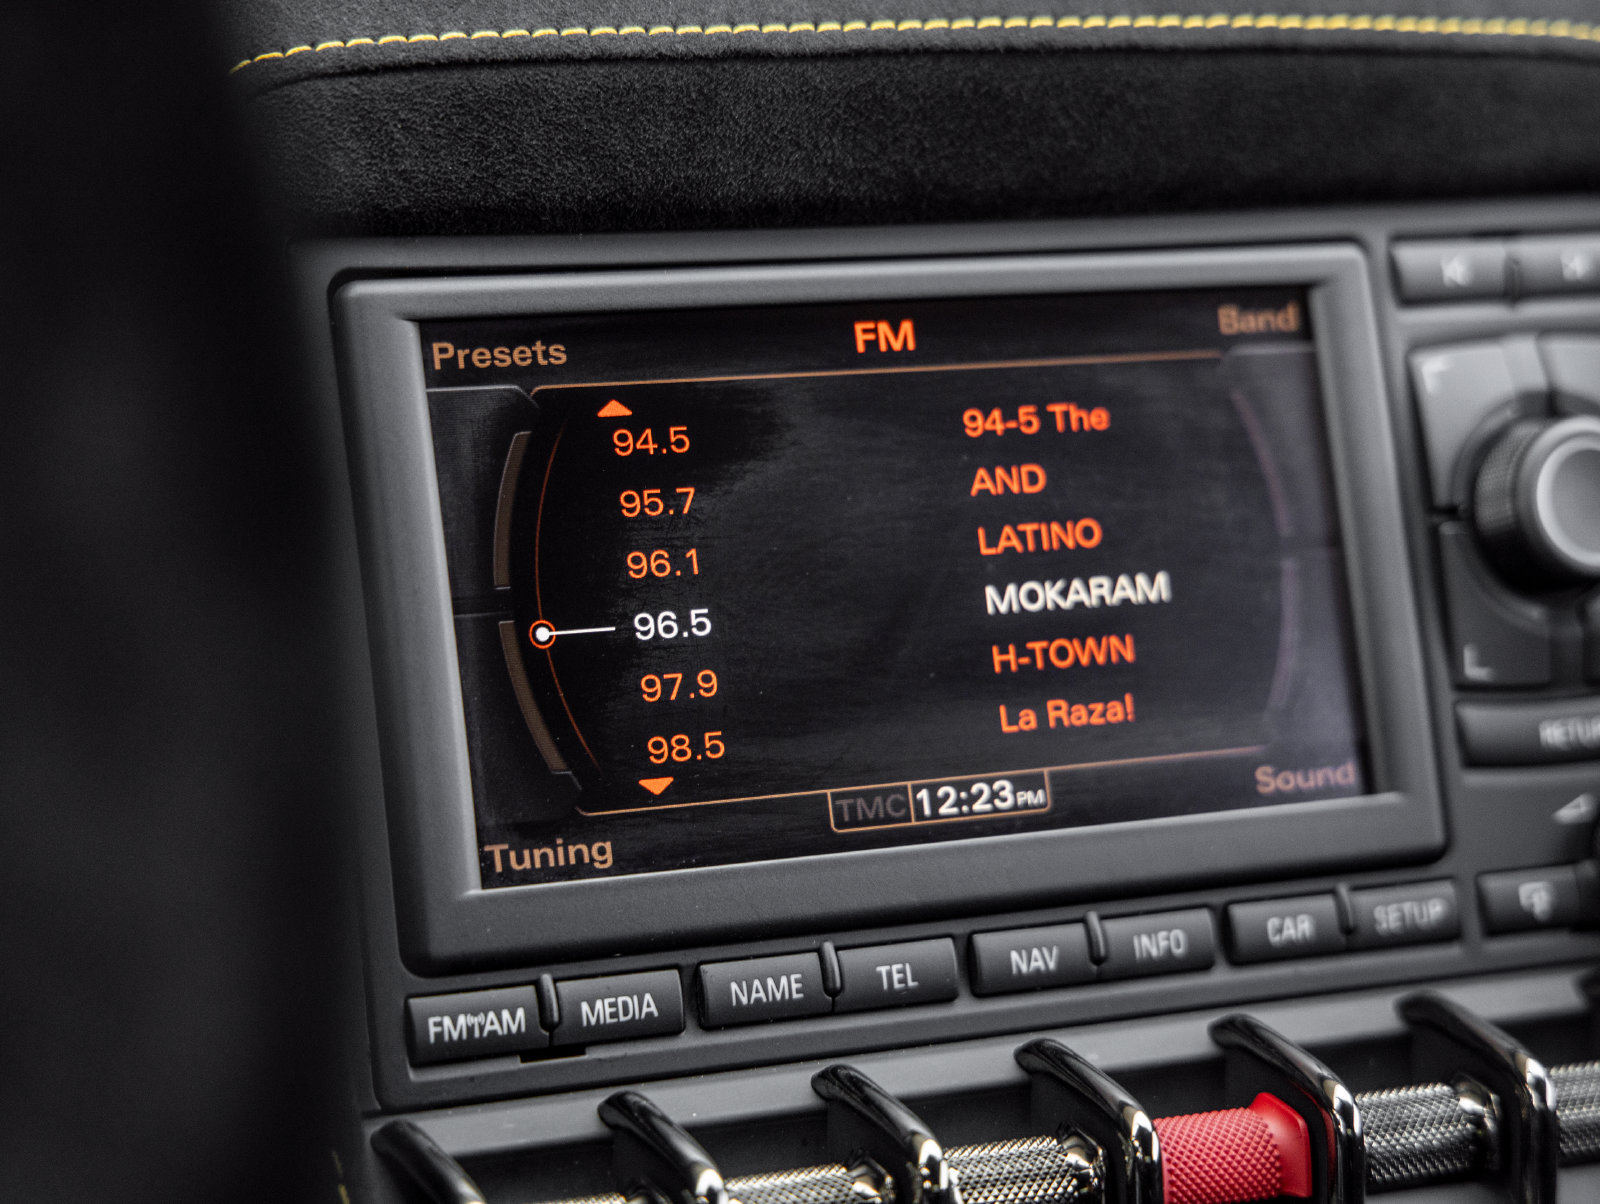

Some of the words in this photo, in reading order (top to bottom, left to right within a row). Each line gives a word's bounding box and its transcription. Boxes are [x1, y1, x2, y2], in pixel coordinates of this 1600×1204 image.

[1217, 302, 1299, 335] Band
[854, 319, 917, 354] FM
[432, 340, 568, 370] Presets
[963, 405, 1041, 438] 94-5
[1047, 403, 1111, 433] The
[612, 426, 691, 457] 94.5
[970, 463, 1047, 497] AND
[619, 487, 696, 518] 95.7
[977, 518, 1103, 556] LATINO
[626, 548, 699, 579] 96.1
[985, 571, 1171, 615] MOKARAM
[633, 608, 712, 640] 96.5
[992, 634, 1136, 674] H-TOWN
[640, 669, 718, 702] 97.9
[999, 703, 1038, 734] La
[1046, 692, 1136, 729] Raza!
[647, 731, 725, 764] 98.5
[1254, 762, 1357, 795] Sound
[834, 792, 907, 823] TMC
[914, 779, 1015, 818] 12:23
[1015, 788, 1046, 808] PM
[483, 838, 614, 873] Tuning
[1266, 913, 1316, 946] CAR
[1373, 896, 1445, 932] SETUP
[1009, 945, 1060, 976] NAV
[1132, 928, 1187, 961] INFO
[730, 973, 804, 1007] NAME
[875, 963, 920, 991] TEL
[580, 992, 659, 1027] MEDIA
